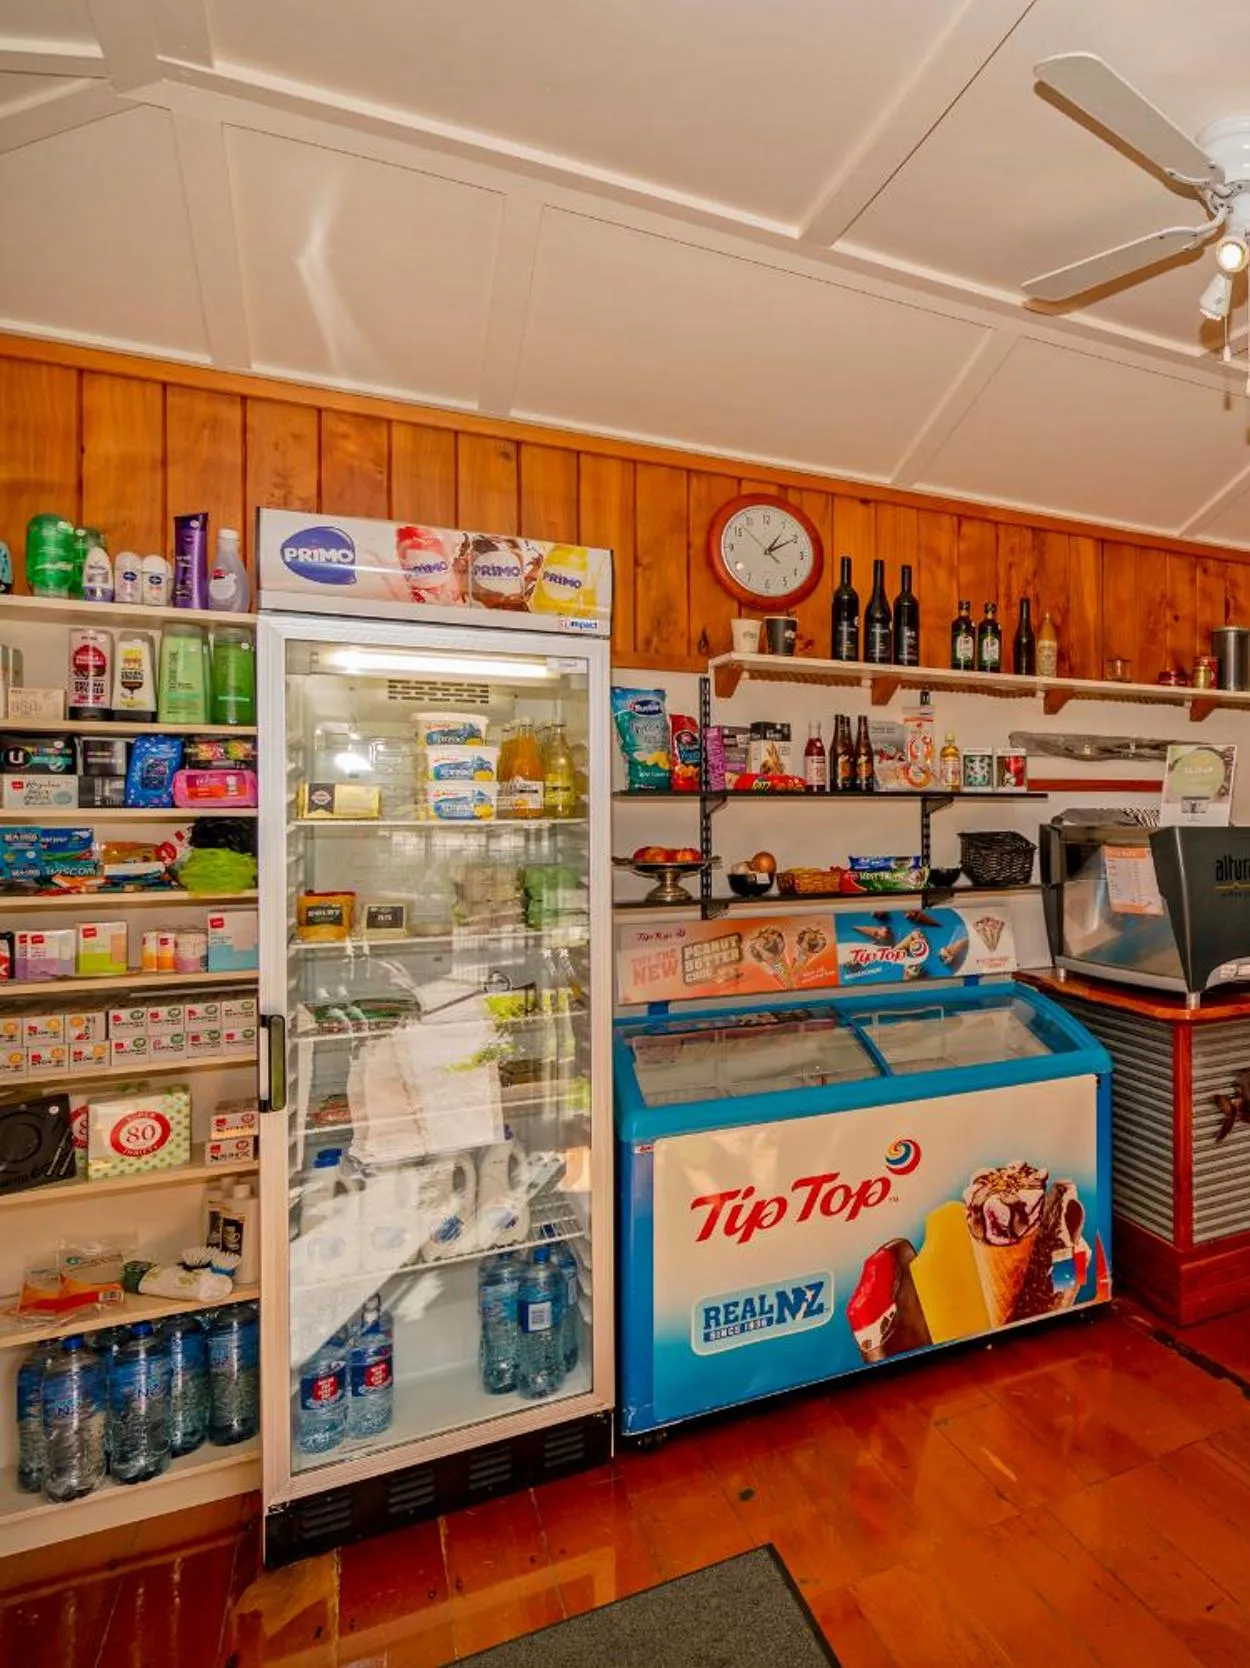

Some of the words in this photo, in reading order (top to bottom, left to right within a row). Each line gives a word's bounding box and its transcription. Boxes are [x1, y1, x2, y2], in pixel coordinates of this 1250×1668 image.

[284, 546, 355, 564] PRIMO
[473, 564, 521, 579] PRIMO
[543, 570, 583, 590] PRIMO
[850, 949, 877, 965] Tip
[878, 947, 906, 964] Top
[631, 957, 679, 986] NEW
[125, 1124, 156, 1144] 80
[690, 1185, 788, 1244] Tip
[791, 1171, 892, 1223] Top
[703, 1294, 774, 1330] REAL
[775, 1280, 825, 1325] NZ
